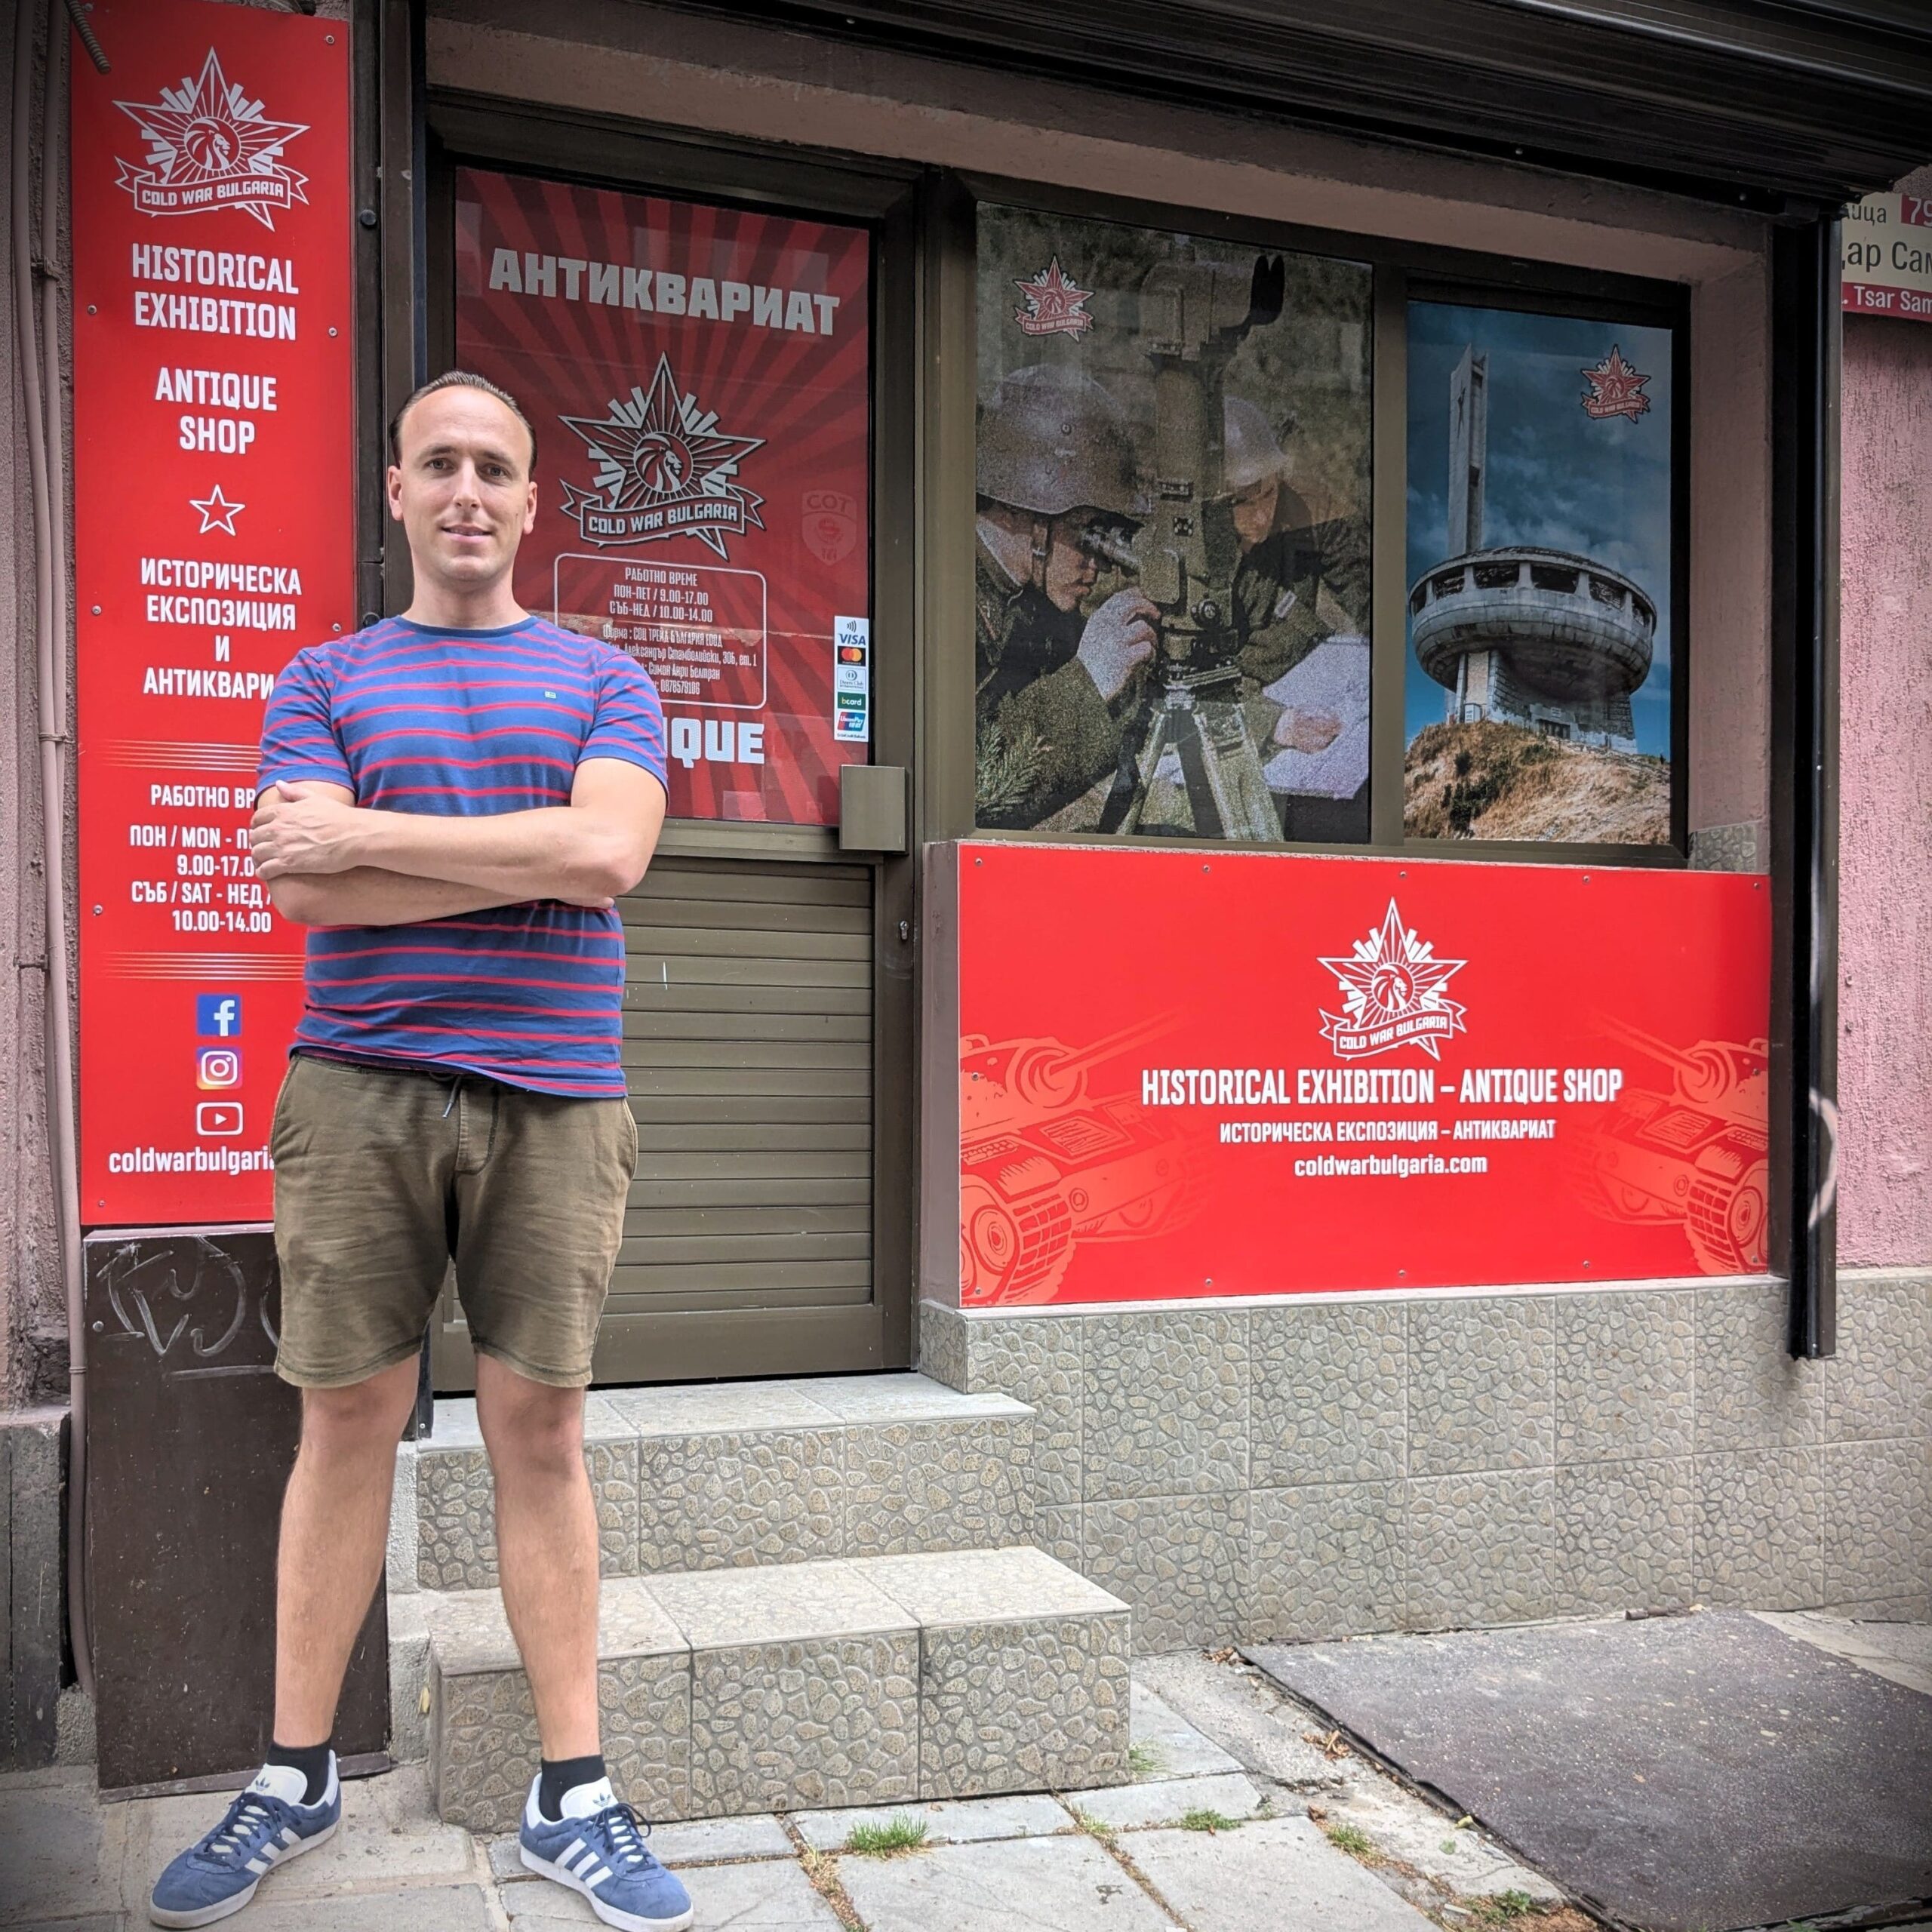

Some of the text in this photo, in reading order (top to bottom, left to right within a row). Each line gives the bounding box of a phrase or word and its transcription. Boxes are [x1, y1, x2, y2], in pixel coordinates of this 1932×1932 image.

[142, 180, 284, 206] COLD WAR BULGARIA
[132, 243, 299, 294] HISTORICAL
[1842, 242, 1881, 273] ар
[489, 248, 841, 336] АНТИКВАРИАТ
[1854, 285, 1895, 309] Tsar
[134, 291, 297, 340] EXHIBITION
[155, 367, 277, 411] ANTIQUE
[180, 415, 255, 454] SHOP
[589, 503, 737, 534] COLD WAR BULGARIA
[141, 558, 302, 595] ИСТОРИЧЕСКА
[625, 567, 698, 587] РАБОТНО ВРЕМЕ
[614, 584, 651, 601] ПОН-ПЕТ
[660, 589, 709, 606] 9.00-17.00
[147, 595, 297, 631] ЕКСПОЗИЦИЯ
[609, 601, 651, 617] СЪБ-НЕД
[659, 605, 713, 623] 10.00-14.00
[215, 635, 230, 662] И
[838, 633, 866, 646] VISA
[143, 667, 275, 700] АНТИКВАРИ
[841, 697, 862, 706] bcard
[151, 784, 229, 808] РАБОТНО
[130, 825, 167, 847] ПОН
[181, 826, 221, 848] MON
[177, 854, 255, 877] 9.00-17.0
[131, 881, 168, 903] СЪБ
[181, 882, 212, 904] SAT
[227, 883, 263, 909] НЕД
[172, 910, 272, 933] 10.00-14.00
[1339, 1015, 1448, 1050] COLD WAR BULGARIA
[1142, 1069, 1291, 1106] HISTORICAL
[1297, 1069, 1435, 1104] EXHIBITION
[1460, 1068, 1558, 1105] ANTIQUE
[1563, 1068, 1623, 1103] SHOP
[1220, 1121, 1334, 1143] ИСТОРИЧЕСКА
[1337, 1121, 1438, 1143] ЕКСПОЗИЦИЯ
[1453, 1119, 1556, 1140] АНТИКВАРИАТ
[109, 1144, 275, 1177] coldwarbulgari
[1294, 1153, 1488, 1178] coldwarbulgaria.com
